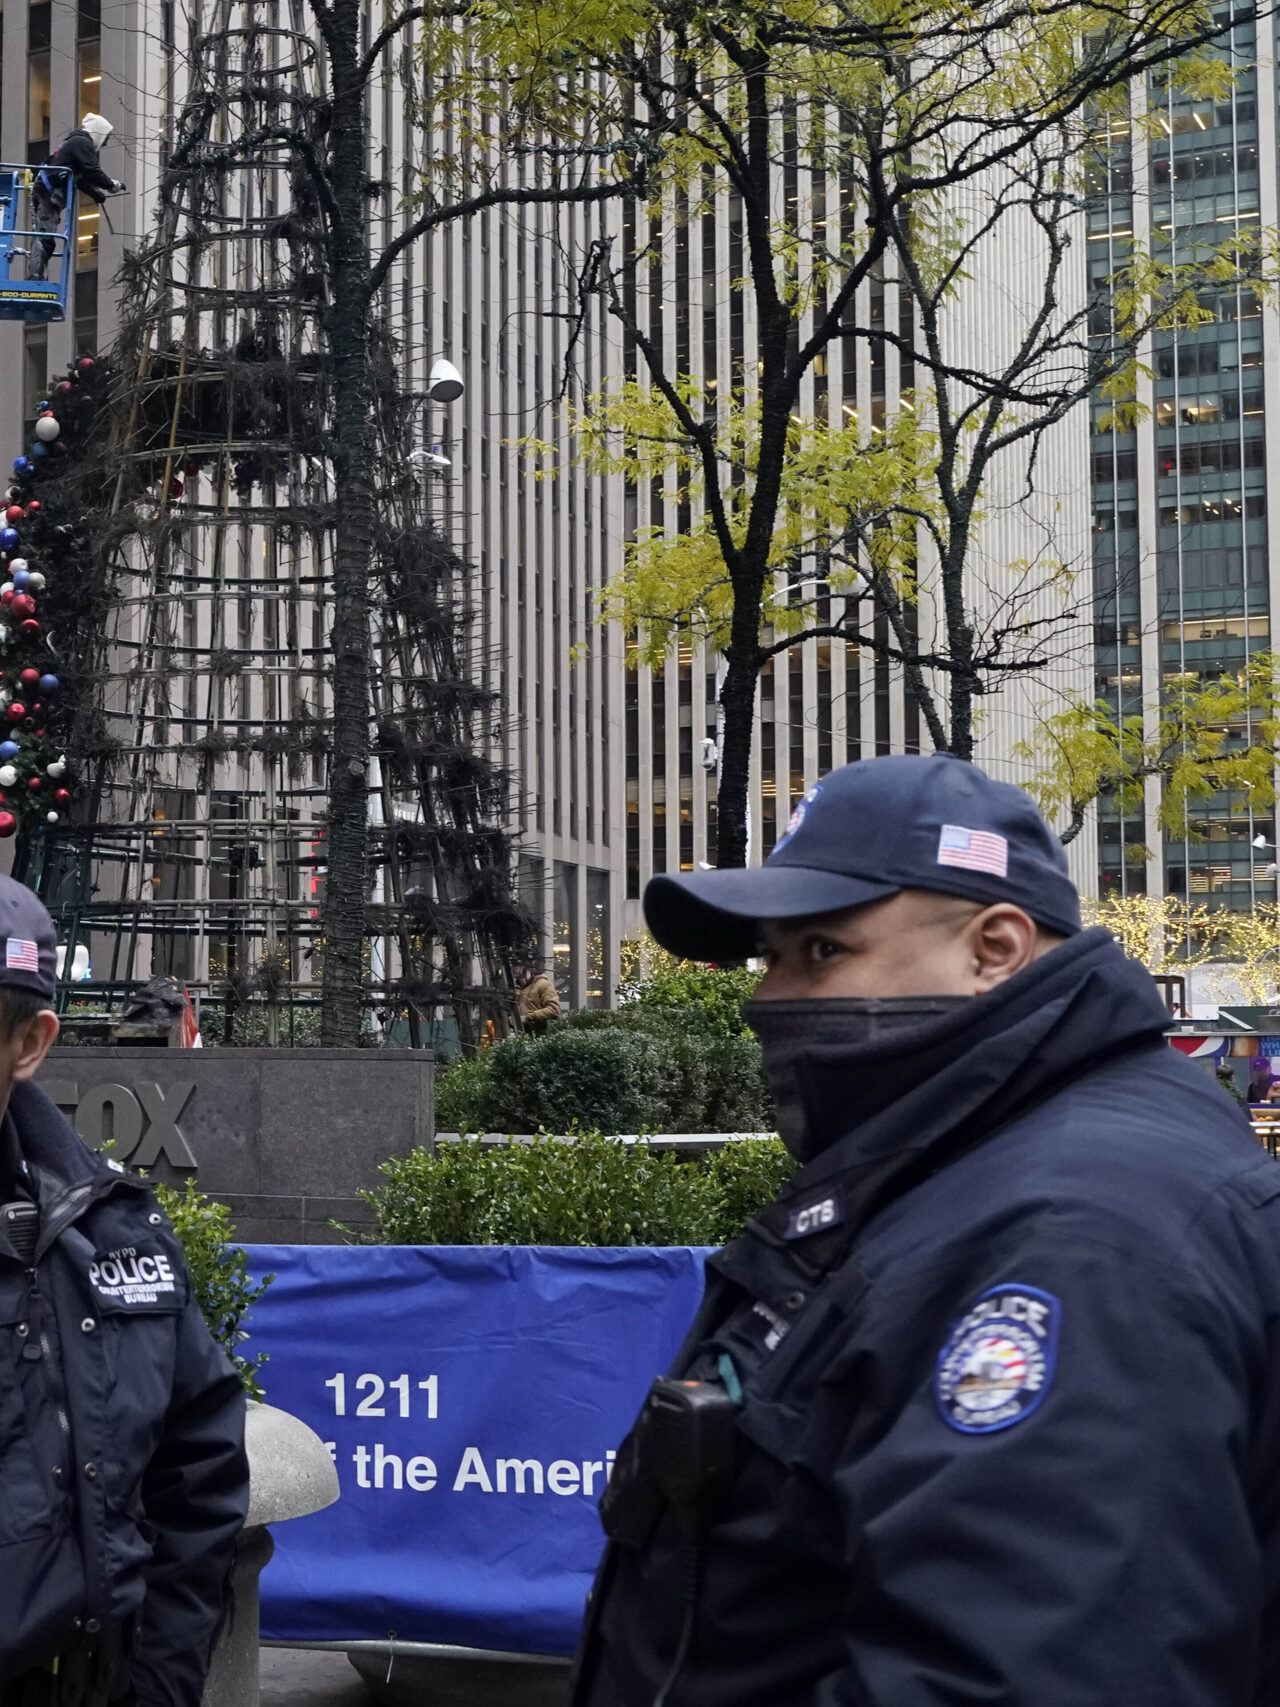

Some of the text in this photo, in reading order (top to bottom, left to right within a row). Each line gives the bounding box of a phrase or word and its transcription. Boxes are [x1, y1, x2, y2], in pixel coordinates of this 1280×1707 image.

[796, 1199, 835, 1233] CTB
[88, 1254, 175, 1286] POLICE
[325, 1372, 438, 1419] 1211
[352, 1443, 438, 1492] the
